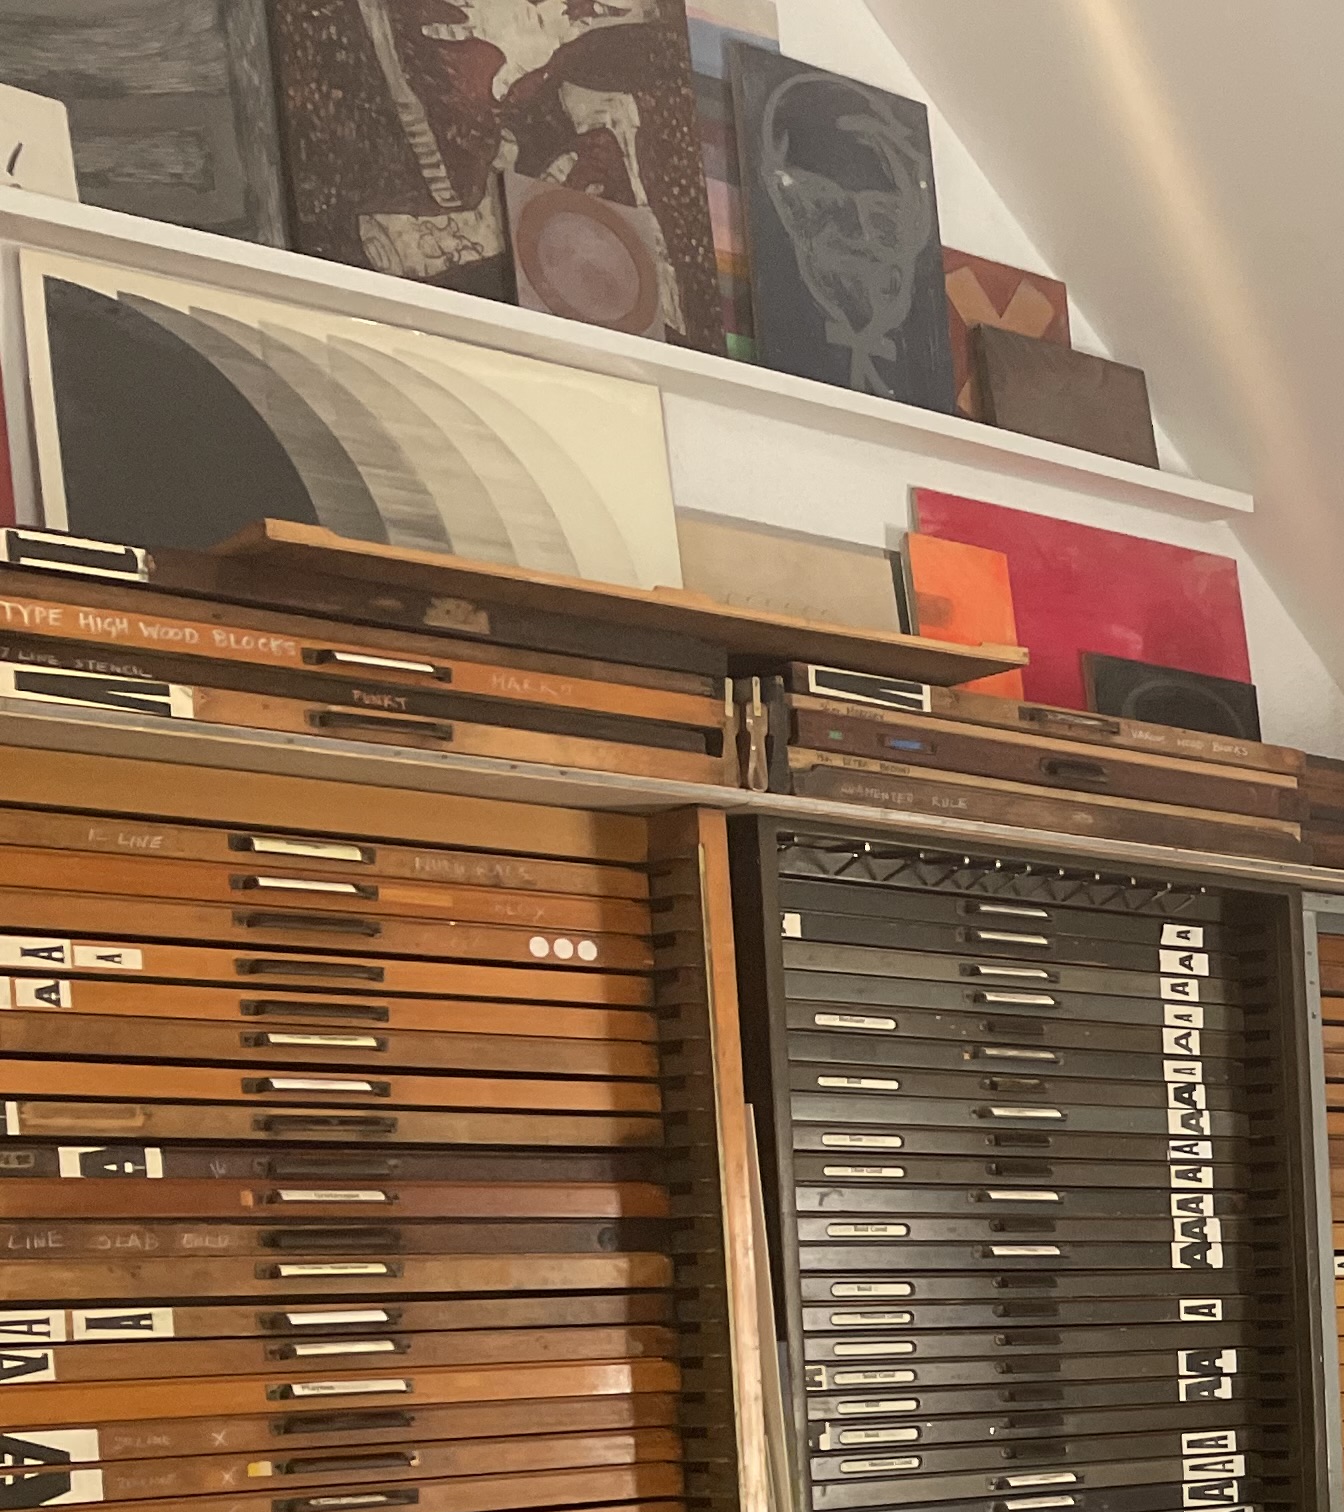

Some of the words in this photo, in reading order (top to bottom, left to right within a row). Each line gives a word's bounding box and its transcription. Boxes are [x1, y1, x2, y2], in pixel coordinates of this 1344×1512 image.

[78, 613, 129, 638] HIGH
[138, 620, 201, 646] WOOD
[212, 628, 297, 658] BLOCKS
